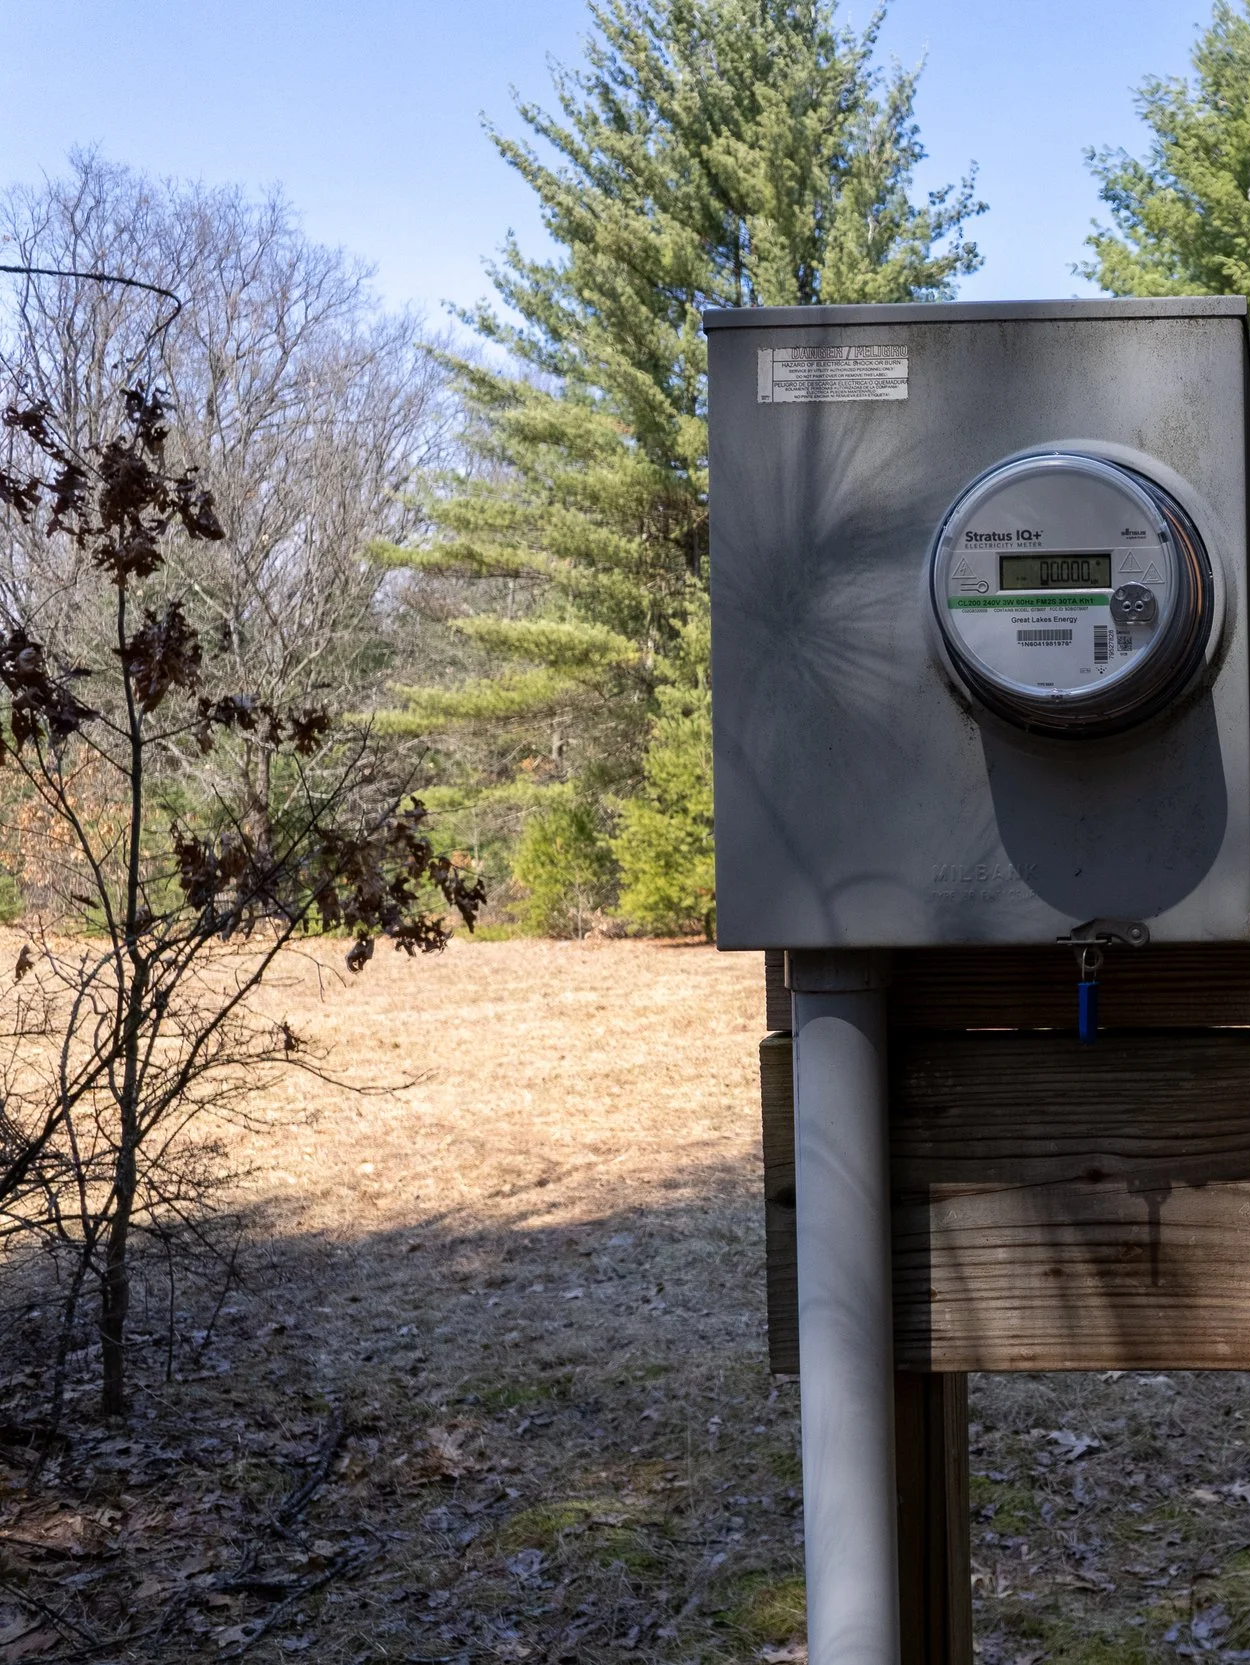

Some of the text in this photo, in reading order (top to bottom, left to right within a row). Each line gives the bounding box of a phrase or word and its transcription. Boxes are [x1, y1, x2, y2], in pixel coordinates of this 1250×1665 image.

[792, 347, 843, 360] DANGER
[855, 345, 908, 358] PELIGRO
[965, 530, 1012, 542] Stratus
[1053, 616, 1078, 624] Energy
[931, 863, 1038, 882] MILBANK
